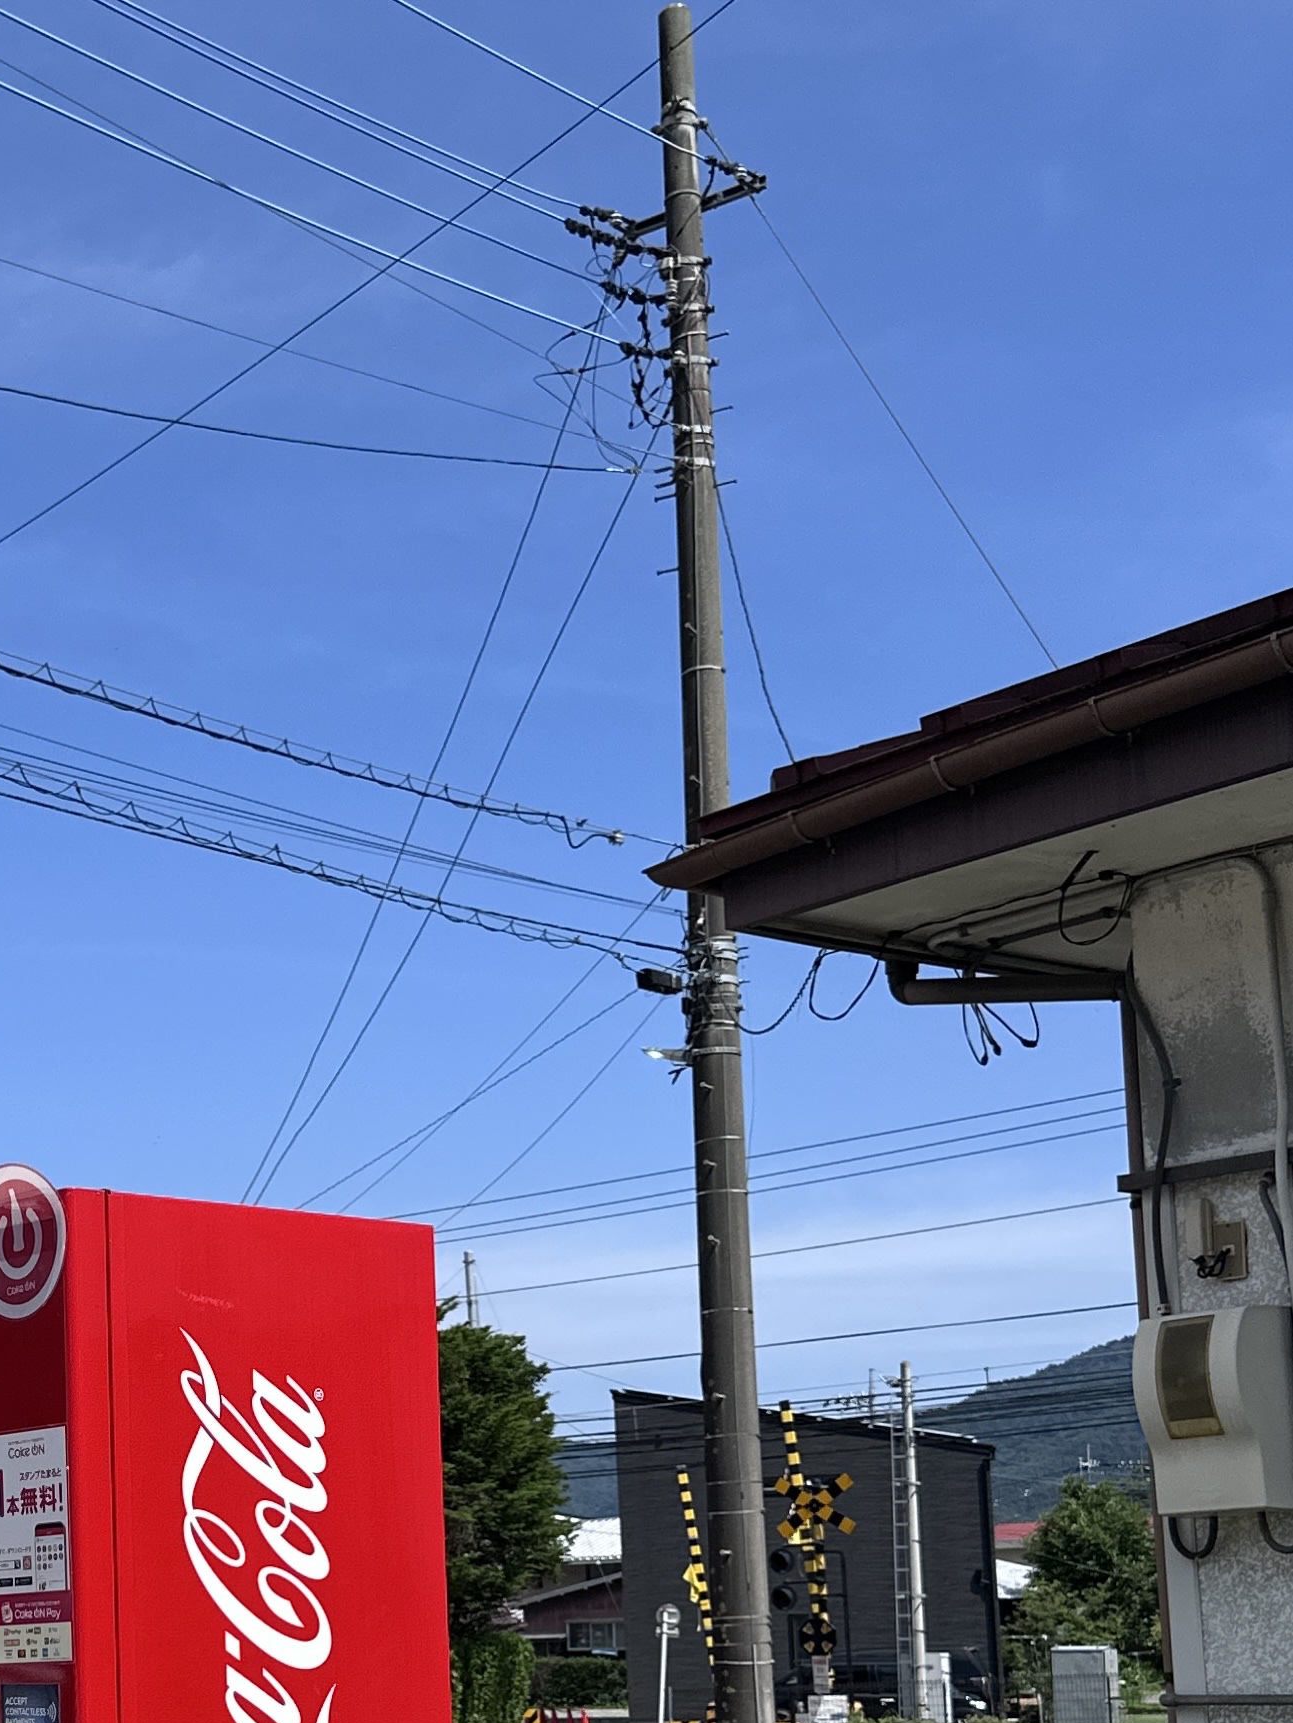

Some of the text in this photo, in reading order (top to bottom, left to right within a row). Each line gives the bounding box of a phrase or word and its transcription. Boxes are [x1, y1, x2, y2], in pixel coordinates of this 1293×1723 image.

[8, 1447, 30, 1460] Coke
[19, 1467, 62, 1481] スタンプたまると
[5, 1696, 28, 1706] ACCEPT
[5, 1706, 47, 1717] CONTACTLESS
